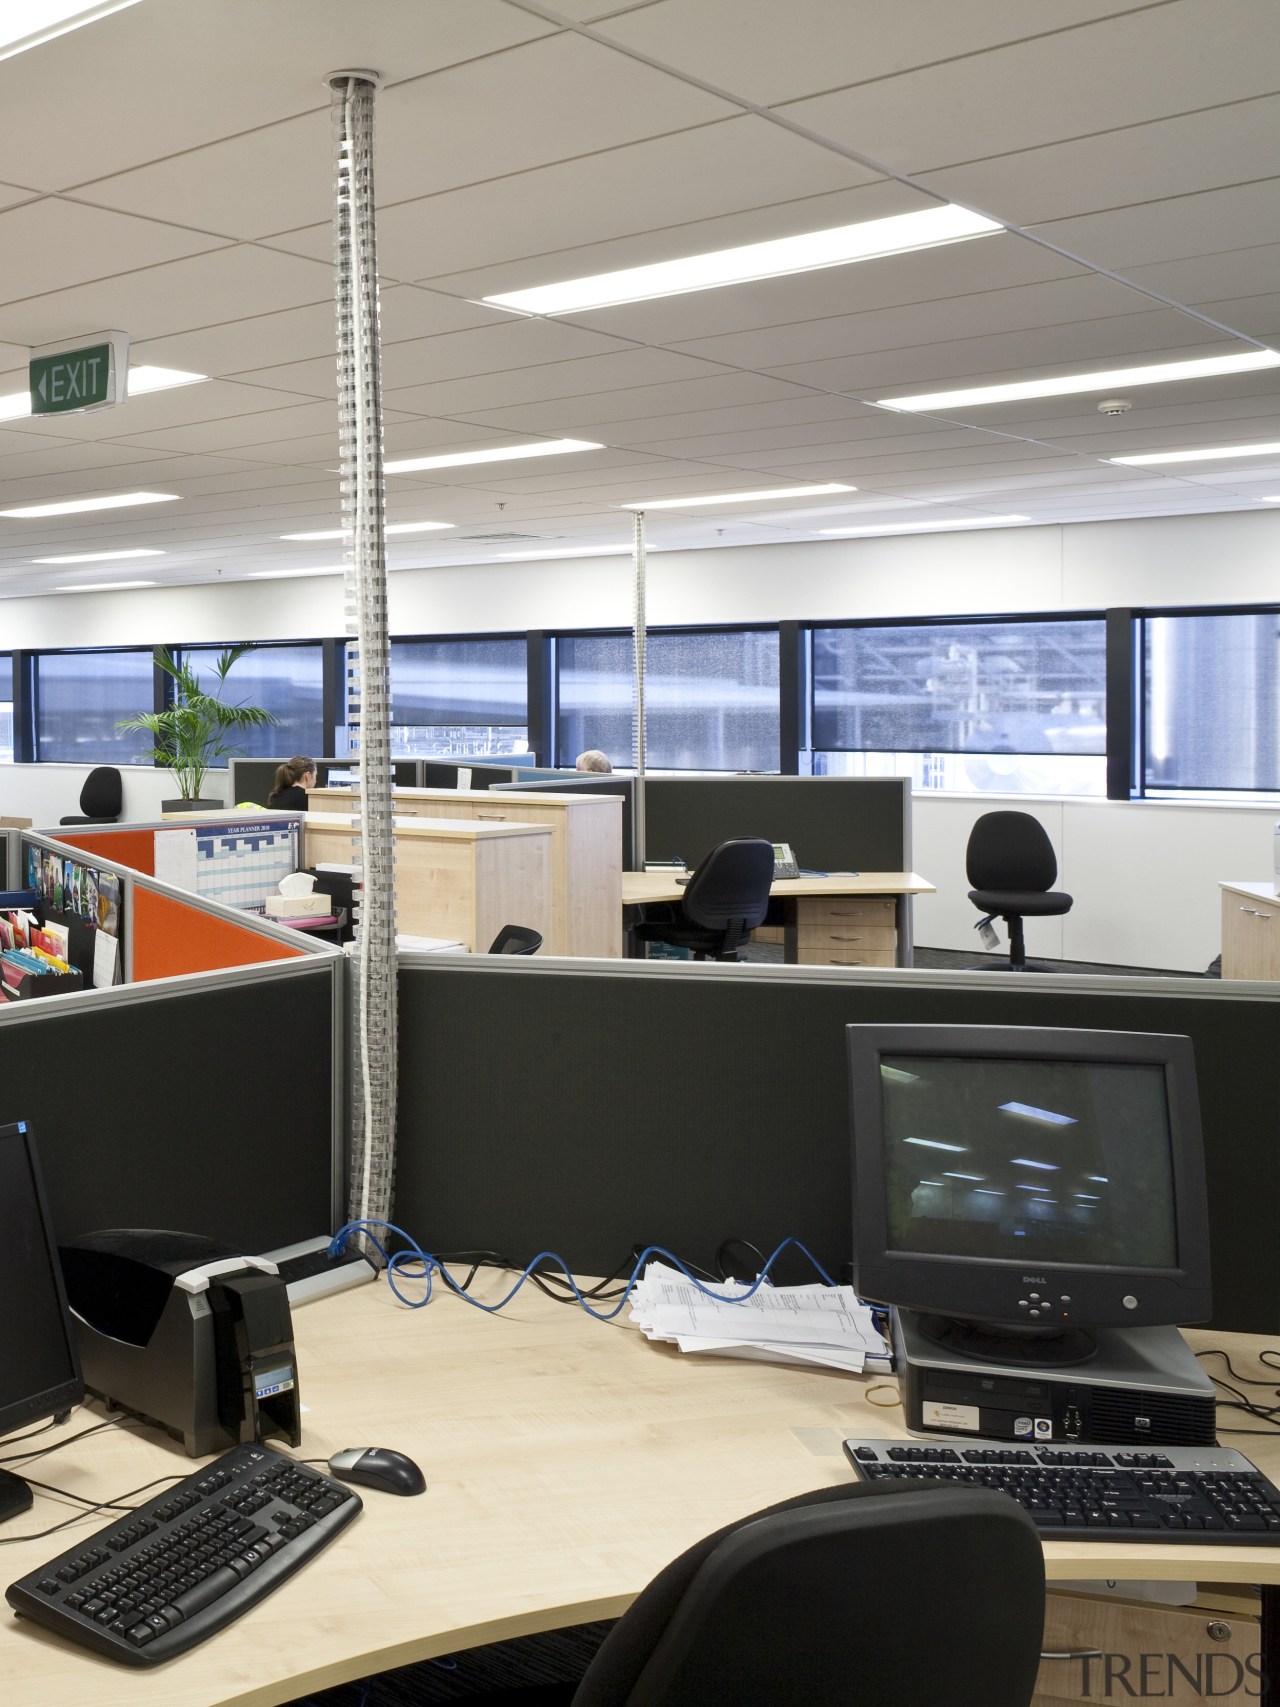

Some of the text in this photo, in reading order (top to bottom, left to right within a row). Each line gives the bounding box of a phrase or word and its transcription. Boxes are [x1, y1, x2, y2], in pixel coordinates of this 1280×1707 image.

[51, 357, 101, 402] EXIT
[239, 825, 261, 833] PLANNER
[1022, 1276, 1047, 1284] DELL
